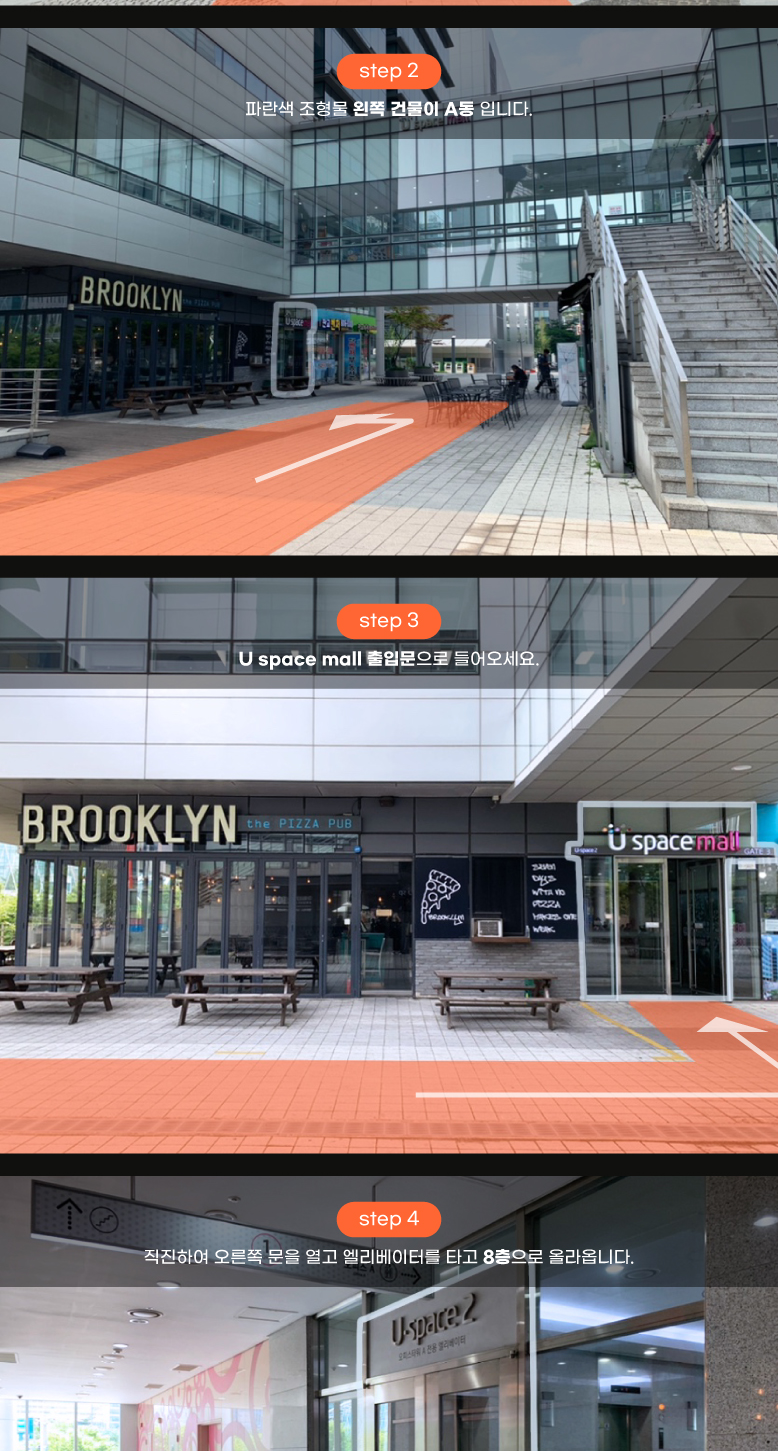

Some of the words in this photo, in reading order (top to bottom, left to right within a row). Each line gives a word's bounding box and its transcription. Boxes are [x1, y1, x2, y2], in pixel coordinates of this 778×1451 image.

[80, 276, 183, 312] BROOKLYN
[22, 804, 237, 844] BROOKLYN
[247, 819, 270, 829] the
[279, 819, 320, 829] PIZZA
[328, 819, 353, 829] PUB
[608, 831, 627, 851] U
[632, 834, 693, 854] space
[696, 831, 740, 852] mall
[532, 900, 561, 908] PIZZA
[461, 1292, 477, 1325] 2
[398, 1348, 422, 1361] 오피스타워
[427, 1343, 437, 1355] 전용
[438, 1335, 466, 1351] 엘리베이터
